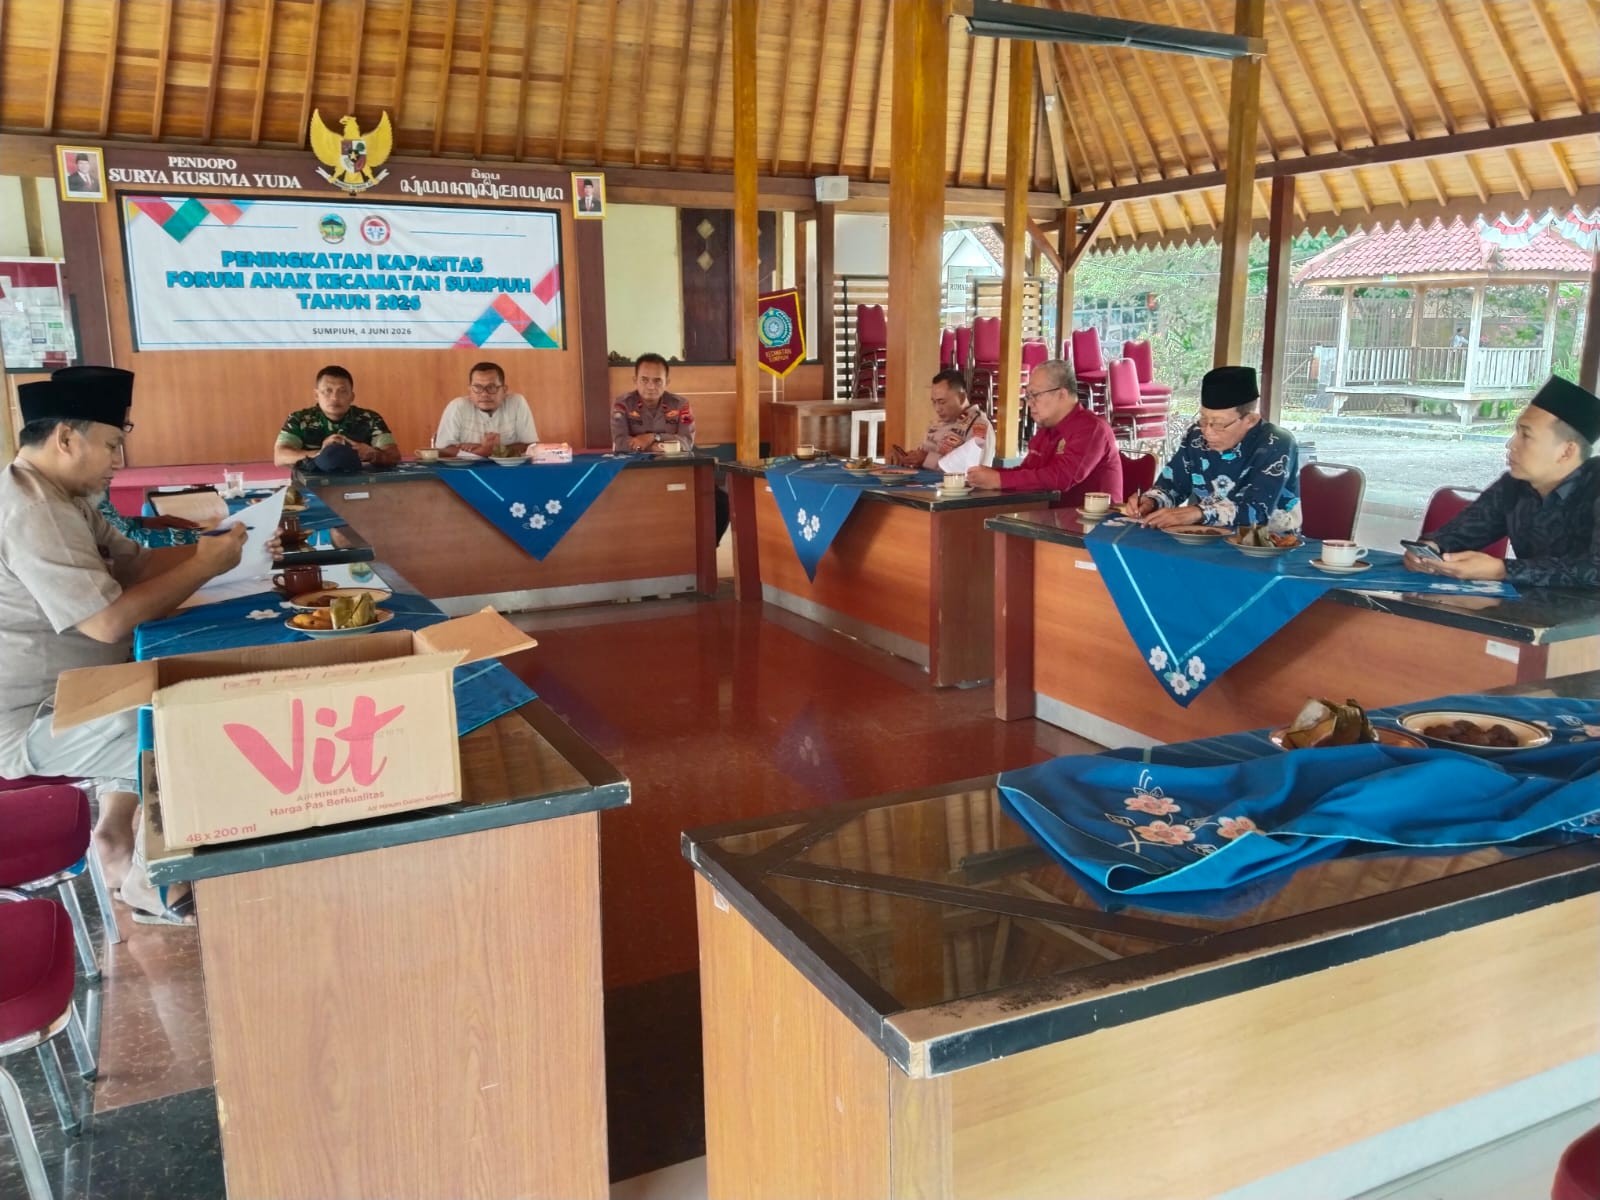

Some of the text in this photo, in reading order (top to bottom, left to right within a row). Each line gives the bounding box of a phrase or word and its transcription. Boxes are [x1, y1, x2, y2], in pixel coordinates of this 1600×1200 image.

[168, 156, 237, 170] PENDOPO
[108, 168, 302, 189] SURYA KUSUMA YUDA
[221, 250, 483, 273] PENINGKATAN KAPASITAS
[167, 271, 531, 293] FORUM ANAK KECAMATAN SUMPIUH
[296, 293, 421, 311] TAHUN 2026
[312, 327, 412, 336] SUMPIUH, 4 JUNI 2026
[222, 695, 406, 795] Vit
[315, 786, 358, 799] MINERAL
[270, 790, 385, 817] Harga Pas Berkualitas
[186, 824, 257, 844] 48 x 200 ml
